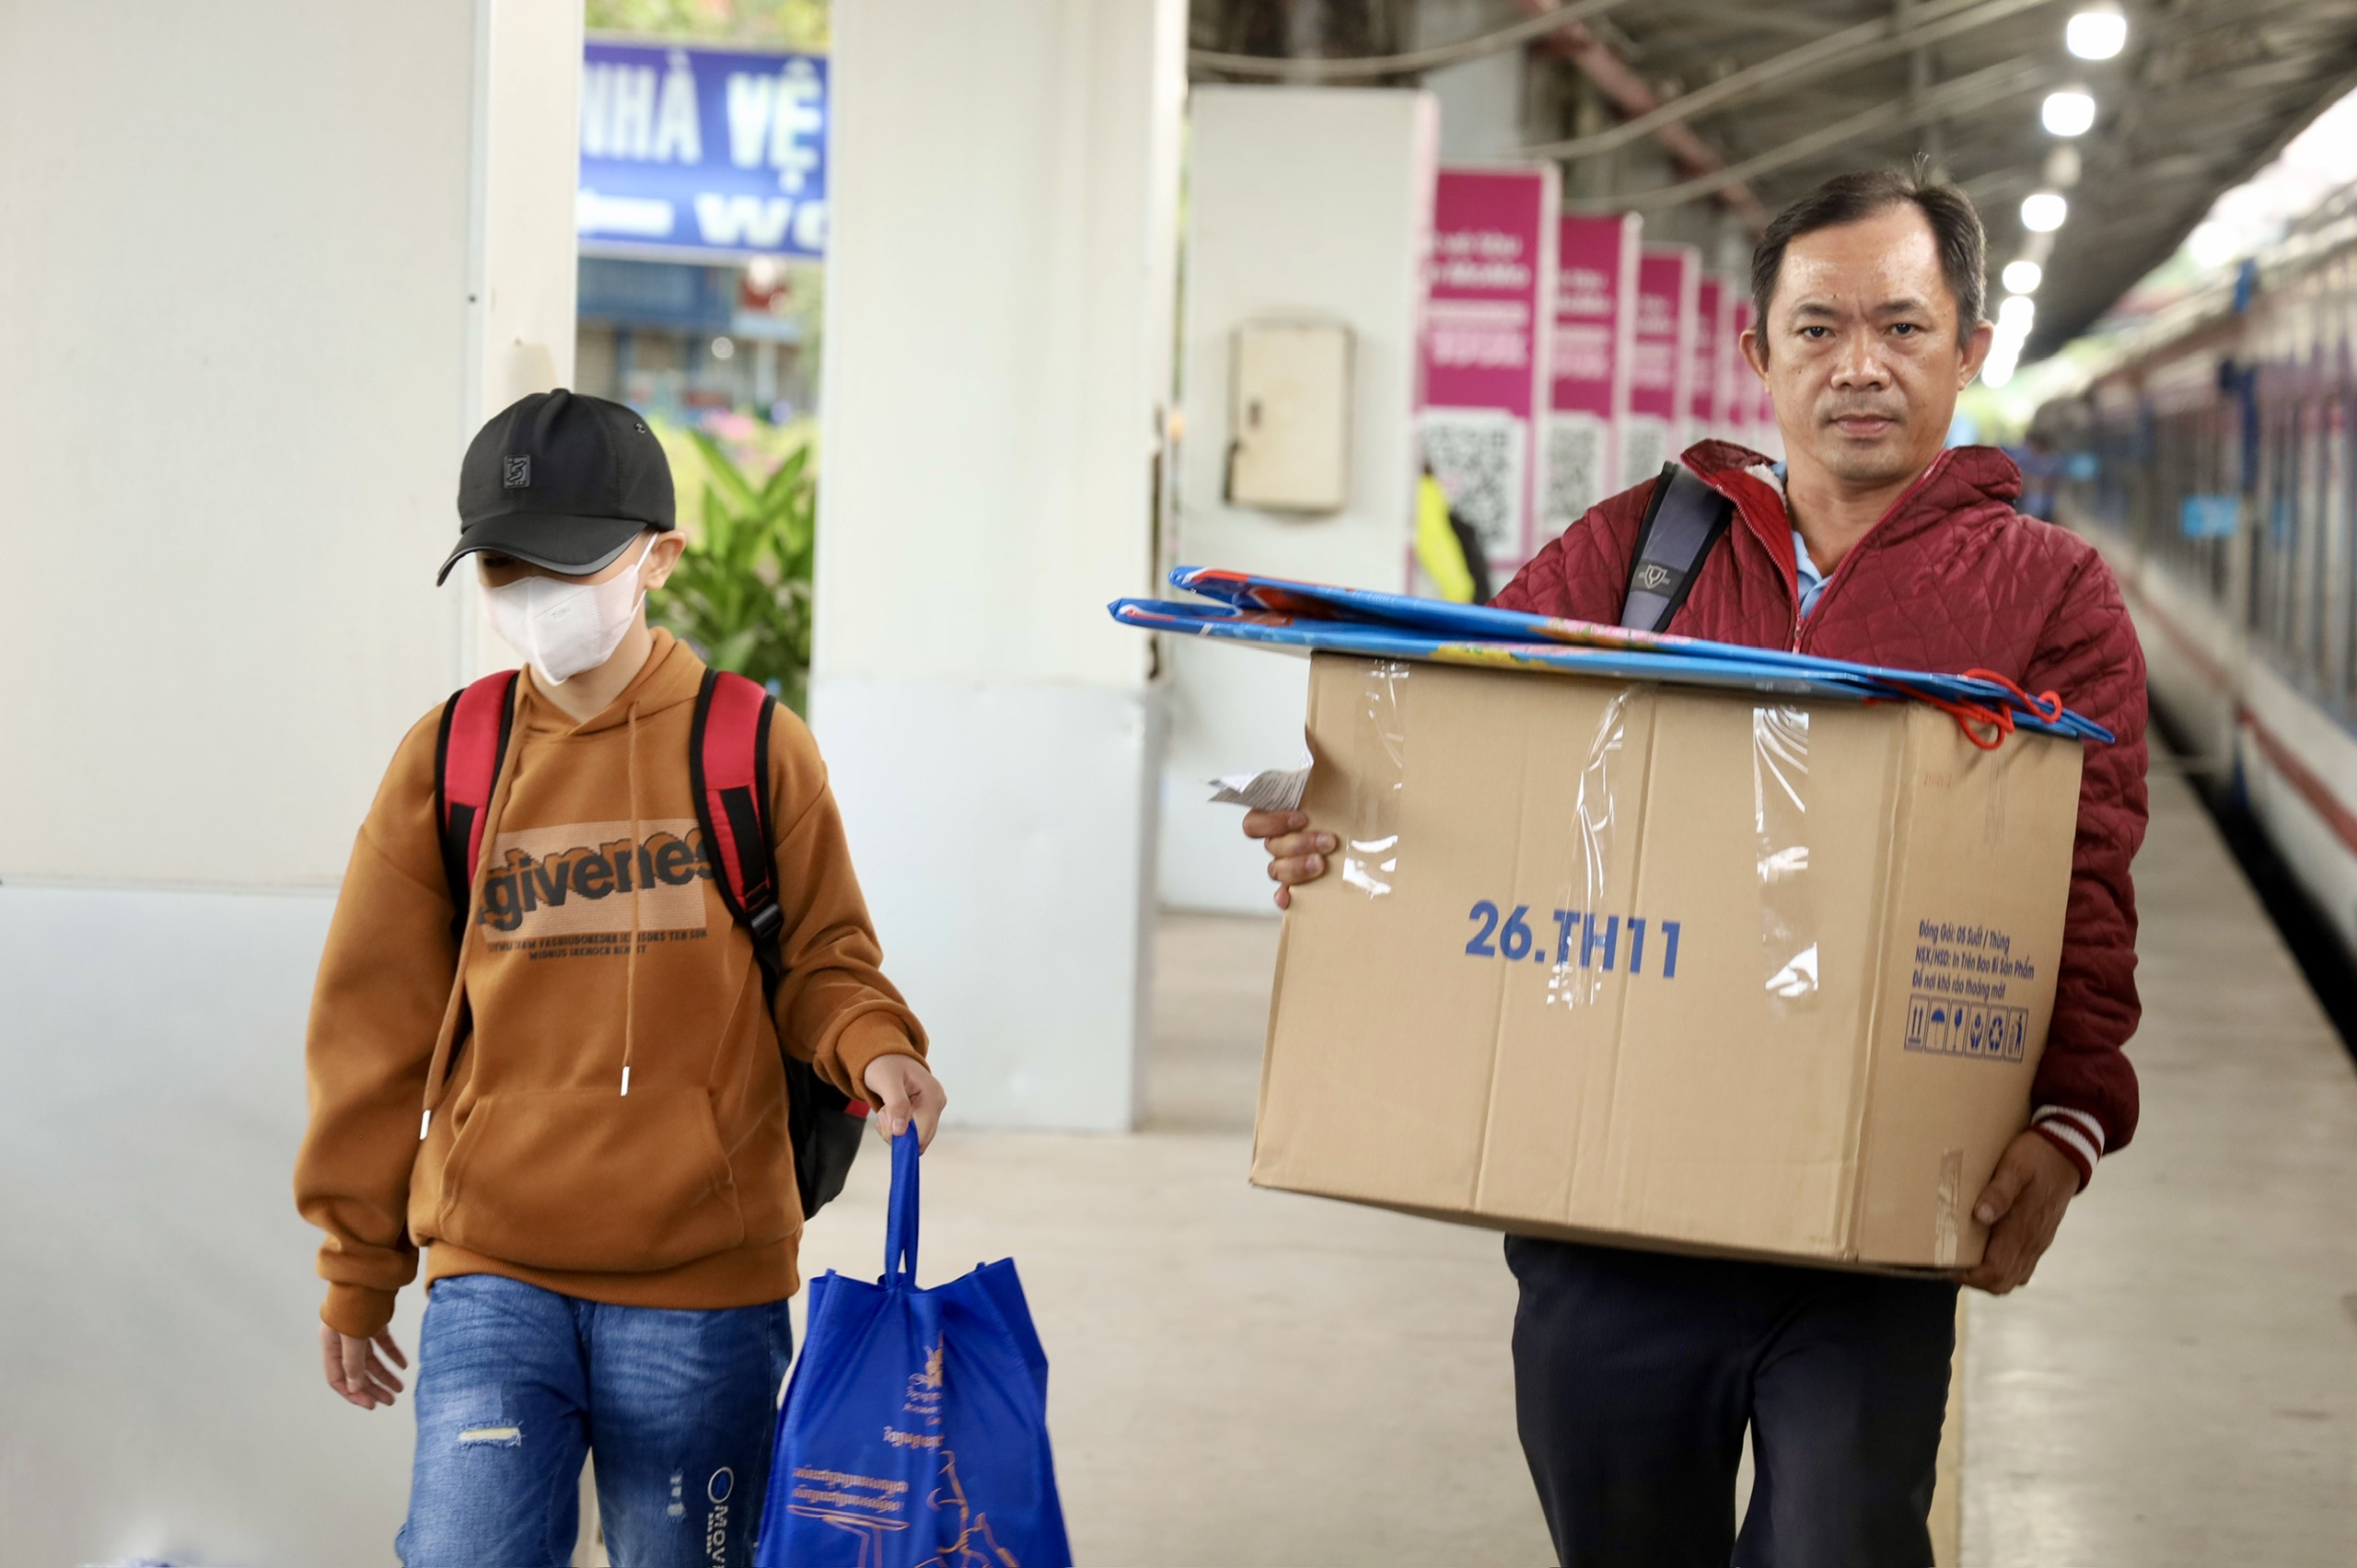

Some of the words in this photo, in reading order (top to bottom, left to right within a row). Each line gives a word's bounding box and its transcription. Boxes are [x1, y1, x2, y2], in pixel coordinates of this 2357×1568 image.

[1465, 900, 1680, 979] 26.TH11
[1919, 918, 1939, 946] Đóng
[1982, 929, 1989, 950] /
[712, 1505, 728, 1568] MOV
